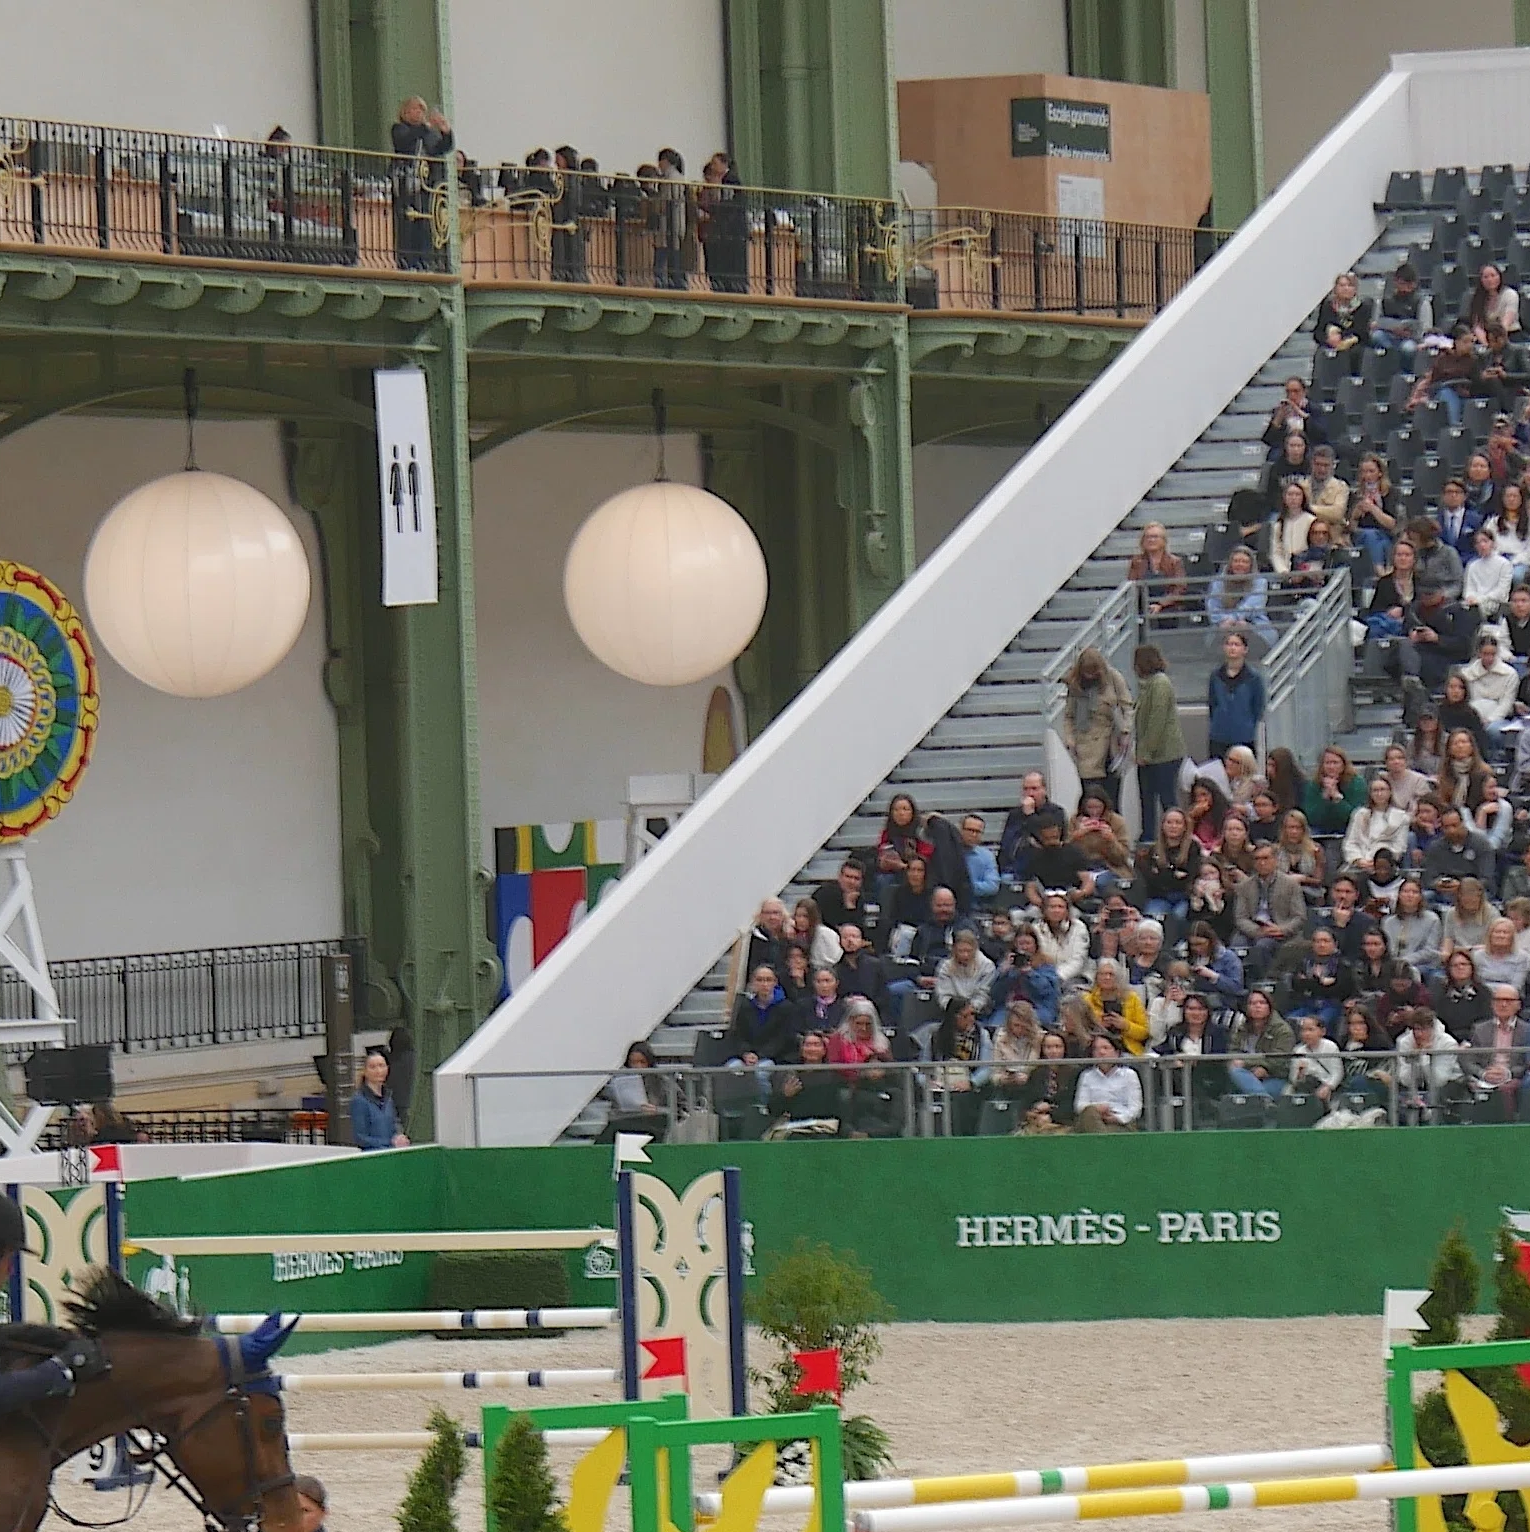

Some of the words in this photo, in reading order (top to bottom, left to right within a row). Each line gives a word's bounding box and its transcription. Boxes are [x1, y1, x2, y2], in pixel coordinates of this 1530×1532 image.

[956, 1208, 1127, 1247] HERMÈS
[1157, 1210, 1282, 1243] PARIS
[89, 1441, 104, 1472] 9
